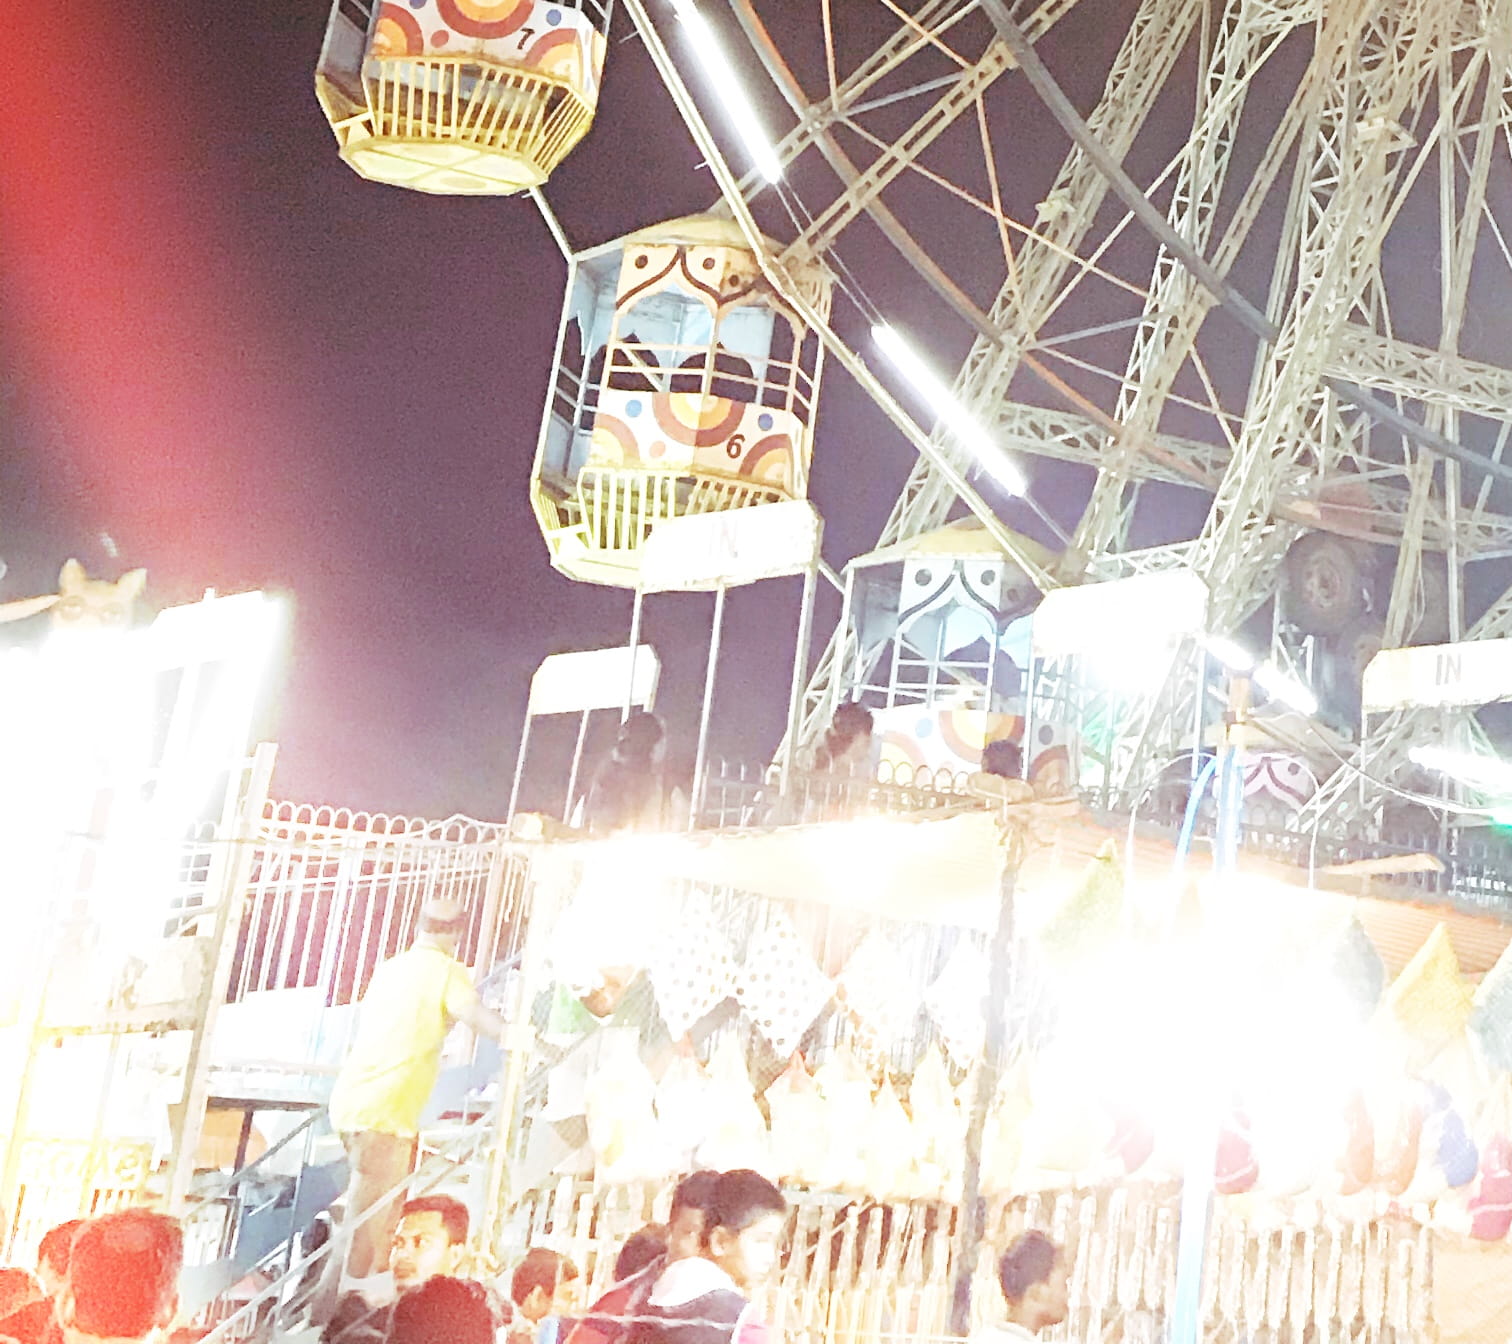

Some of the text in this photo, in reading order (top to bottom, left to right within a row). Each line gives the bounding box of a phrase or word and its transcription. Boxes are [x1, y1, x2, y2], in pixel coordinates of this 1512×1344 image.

[516, 27, 536, 50] 7
[726, 432, 745, 459] 6
[1435, 652, 1462, 687] IN
